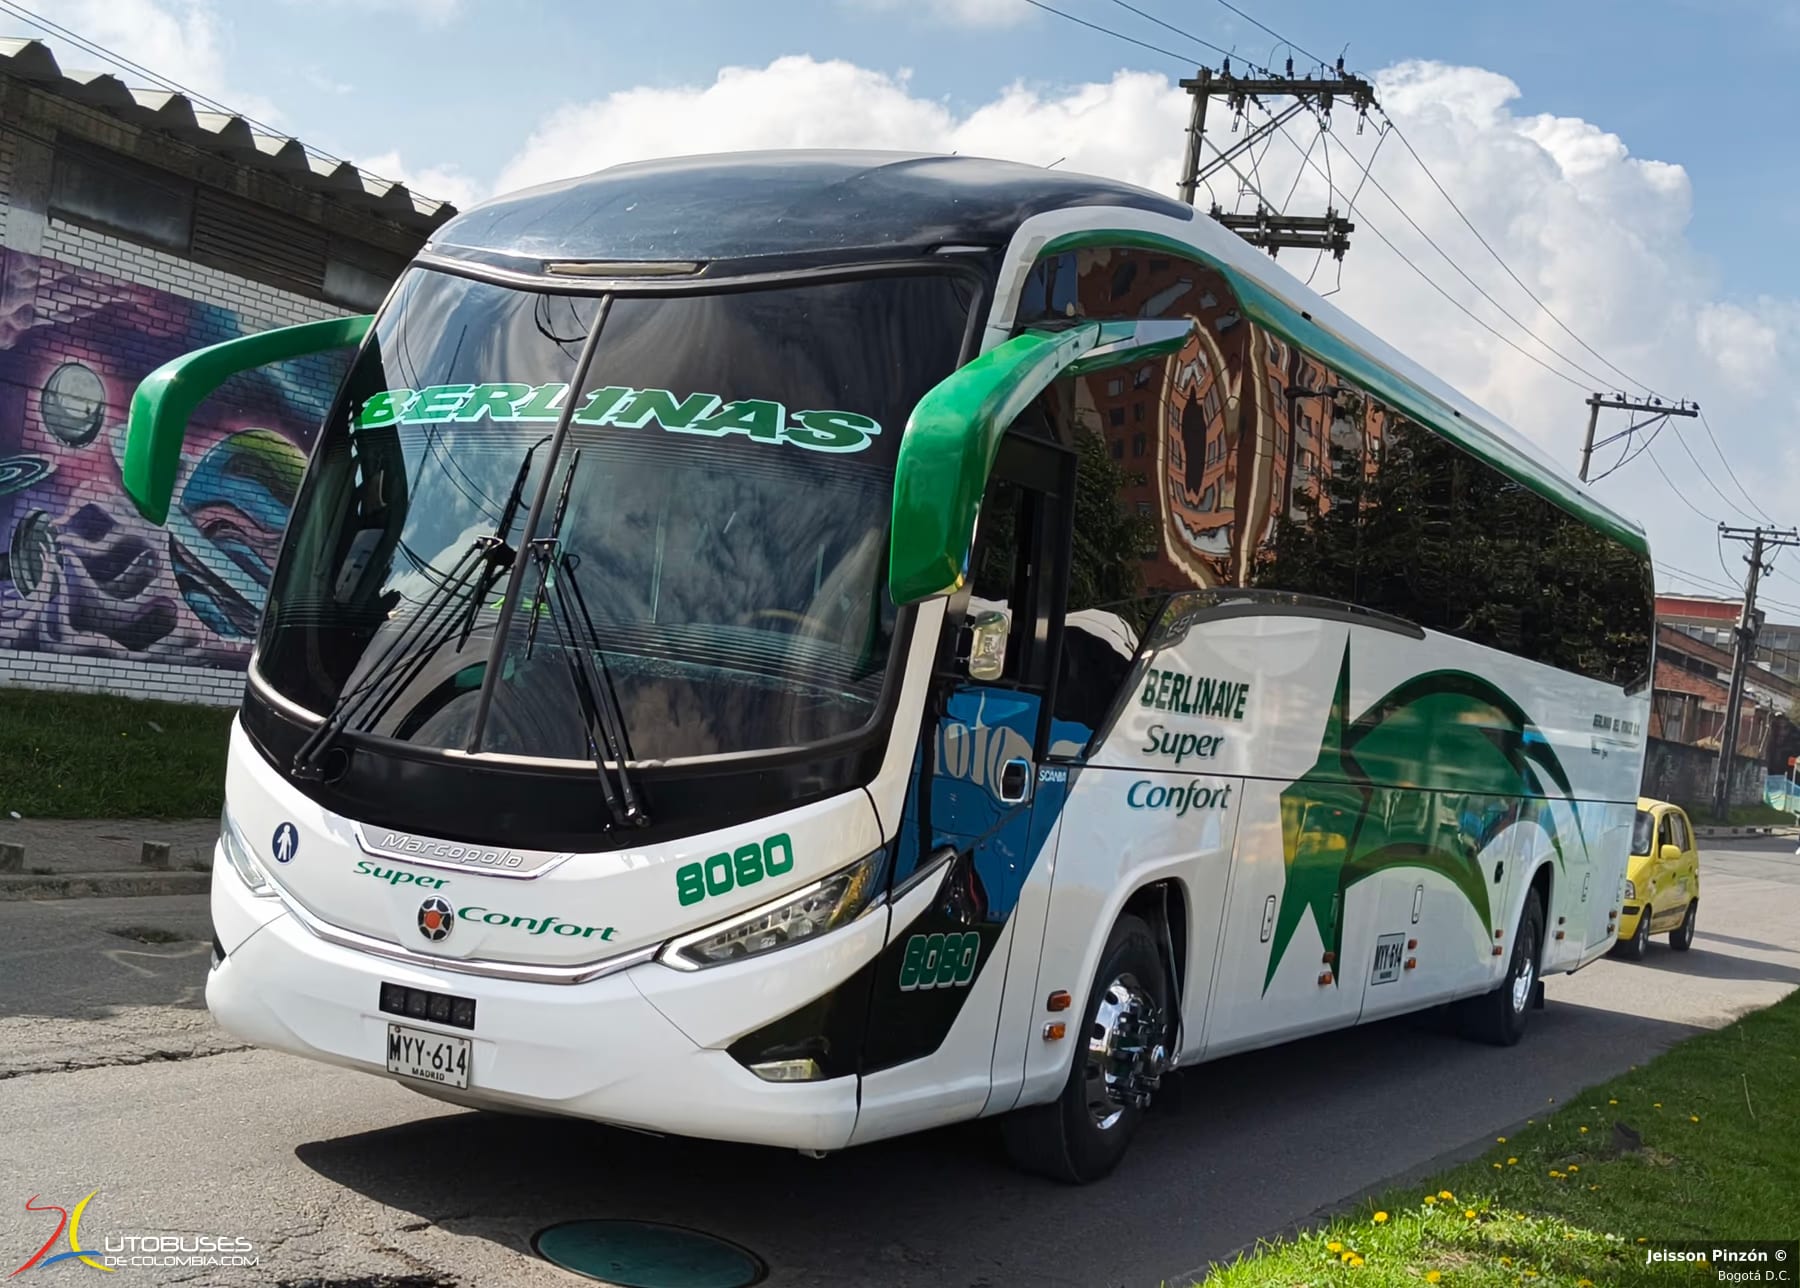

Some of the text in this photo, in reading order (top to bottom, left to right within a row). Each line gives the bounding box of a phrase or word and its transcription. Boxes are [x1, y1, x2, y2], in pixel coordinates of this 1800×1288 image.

[353, 382, 882, 453] BERLINAS
[1141, 669, 1249, 720] BERLINAVE
[1142, 725, 1225, 764] Super
[1126, 779, 1232, 817] Confort
[380, 833, 524, 868] Marcopolo
[675, 832, 794, 907] 8080
[353, 860, 451, 890] Super
[457, 906, 620, 942] Confort
[899, 931, 981, 991] 8080
[411, 1067, 445, 1081] MADRID
